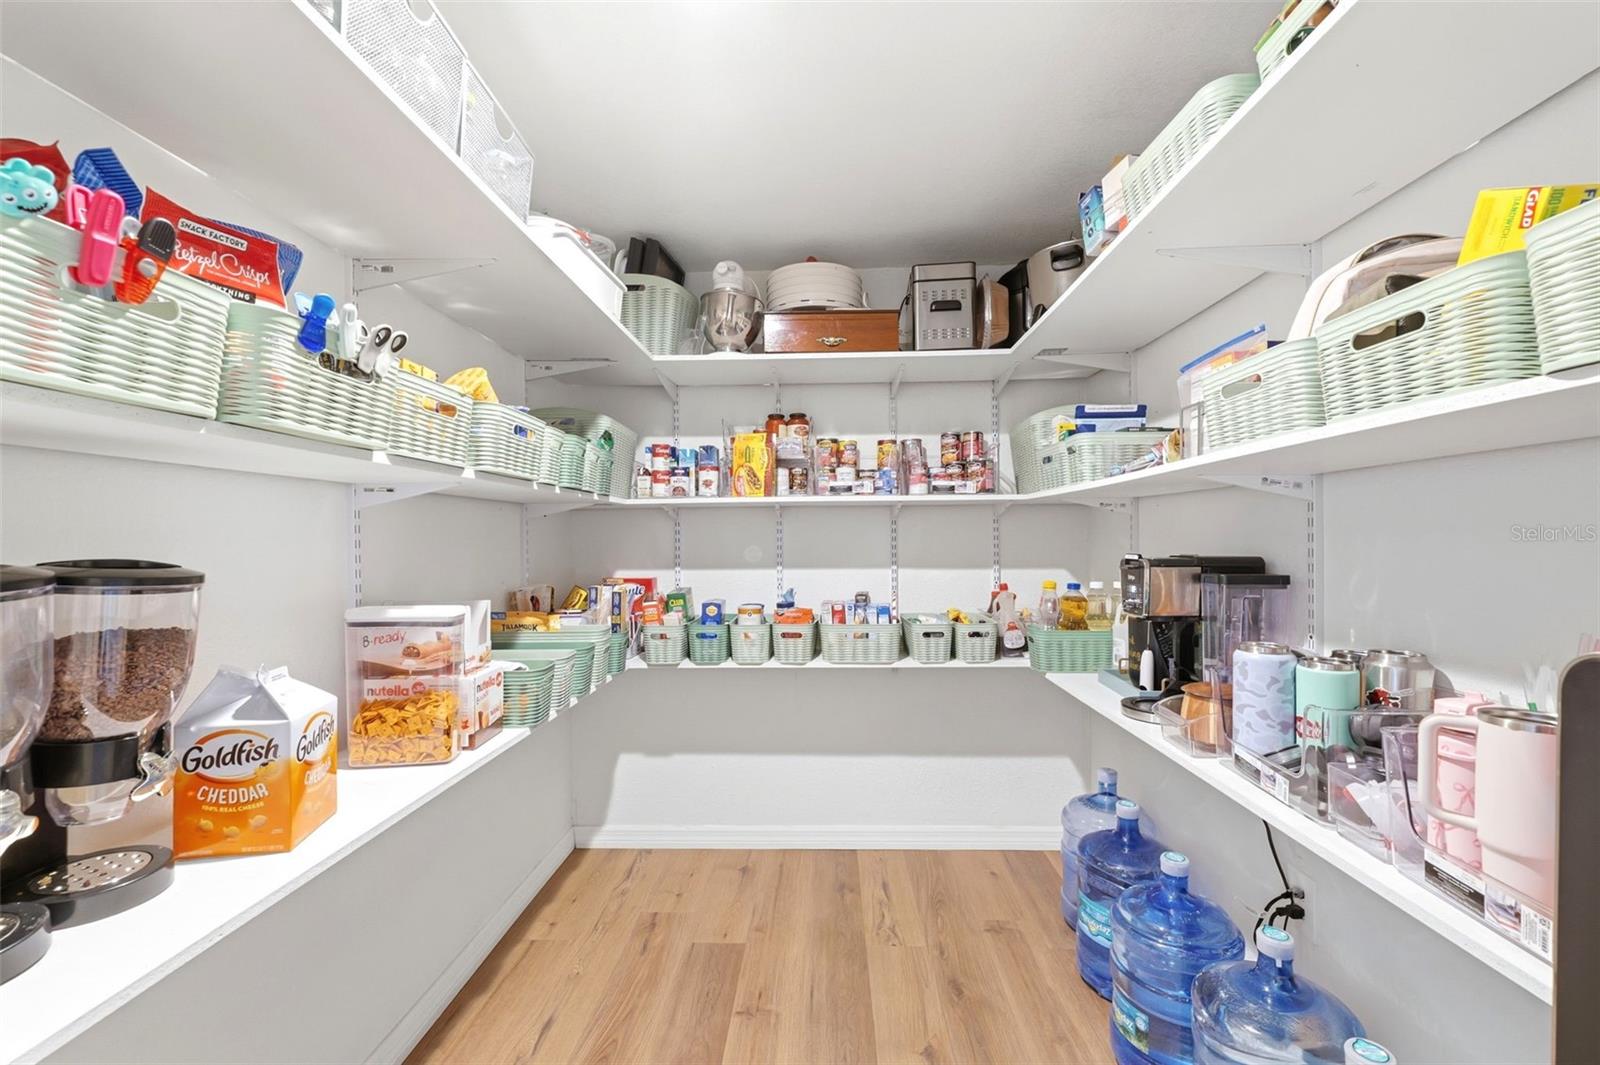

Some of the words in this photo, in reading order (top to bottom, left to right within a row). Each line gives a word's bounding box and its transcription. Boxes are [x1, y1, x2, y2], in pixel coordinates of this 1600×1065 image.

[1522, 189, 1540, 229] GLAD
[179, 220, 207, 236] SNACK
[208, 230, 246, 249] FACTORY
[220, 253, 270, 288] Crisps
[501, 623, 538, 632] TILLAMOOK
[366, 684, 409, 697] nutella
[181, 737, 280, 774] Goldfish
[296, 716, 335, 763] Goldfish
[197, 782, 269, 805] CHEDDAR
